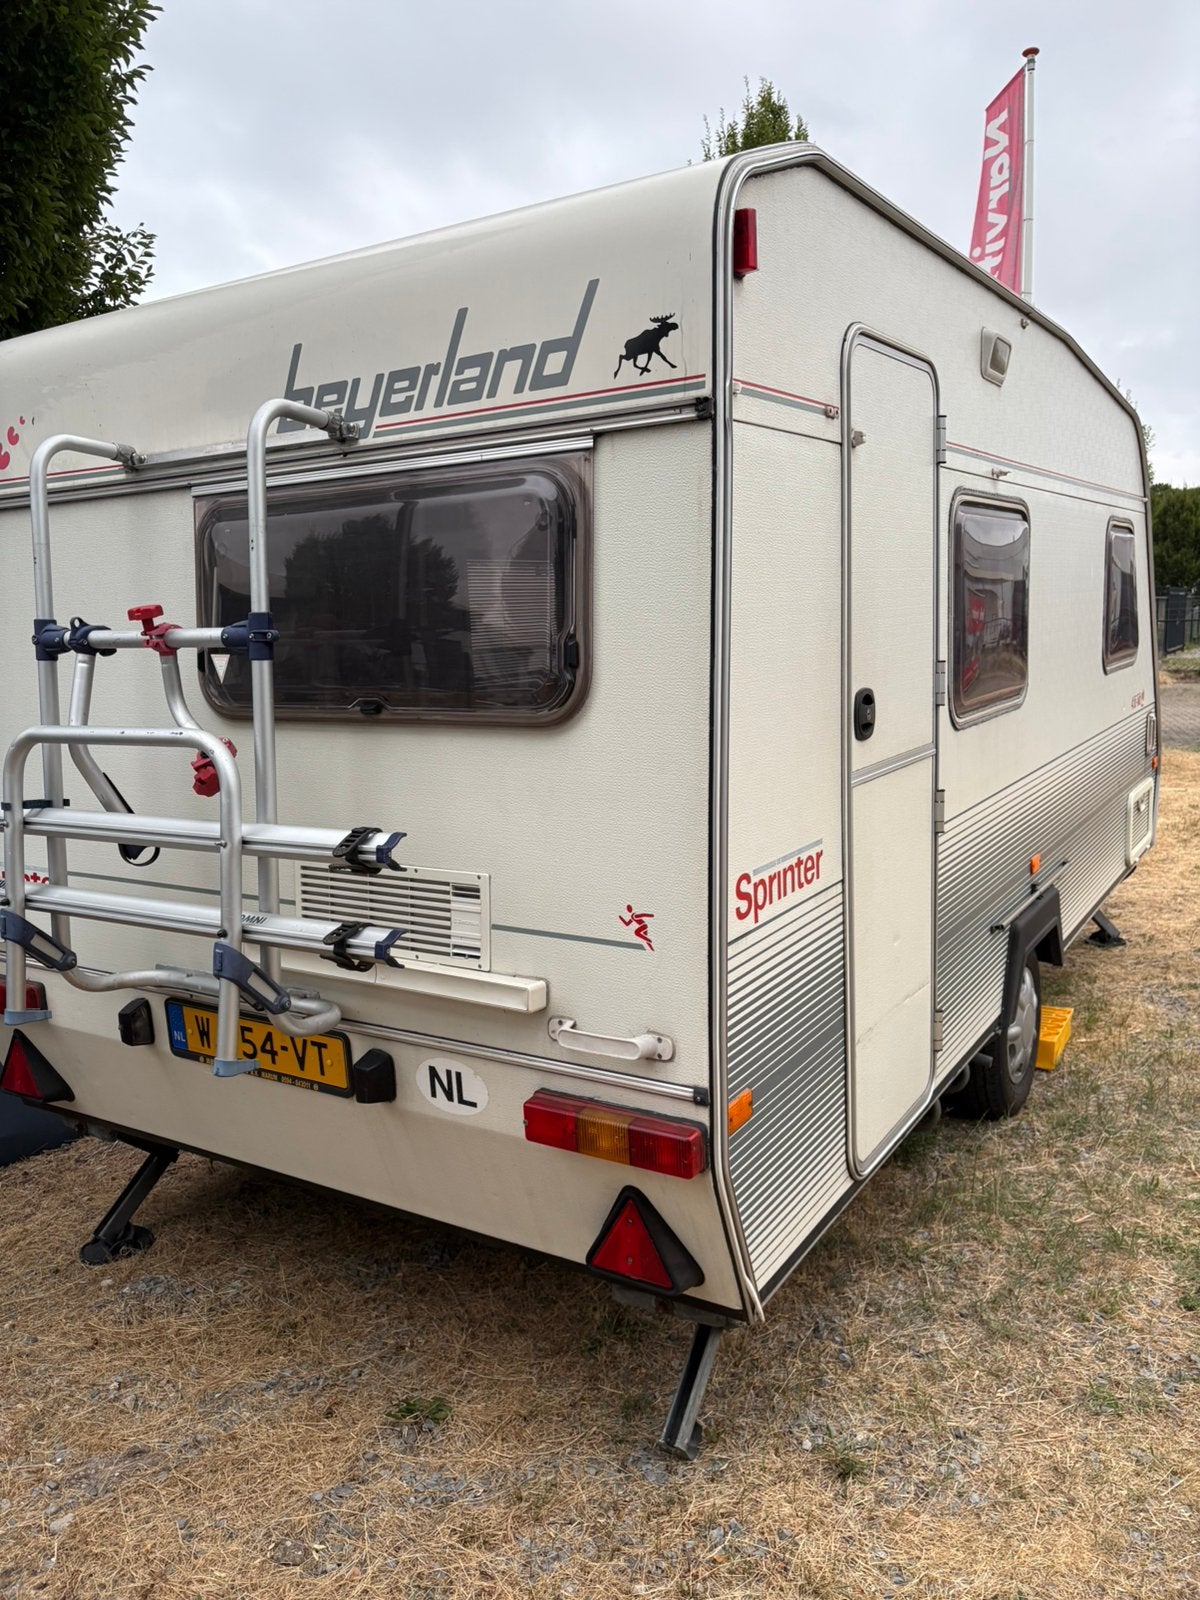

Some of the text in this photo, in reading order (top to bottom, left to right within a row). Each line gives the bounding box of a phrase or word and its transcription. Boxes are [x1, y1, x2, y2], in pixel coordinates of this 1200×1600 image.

[276, 278, 600, 439] beyerland
[735, 849, 823, 924] Sprinter
[173, 1030, 186, 1042] NL
[428, 1065, 478, 1108] NL
